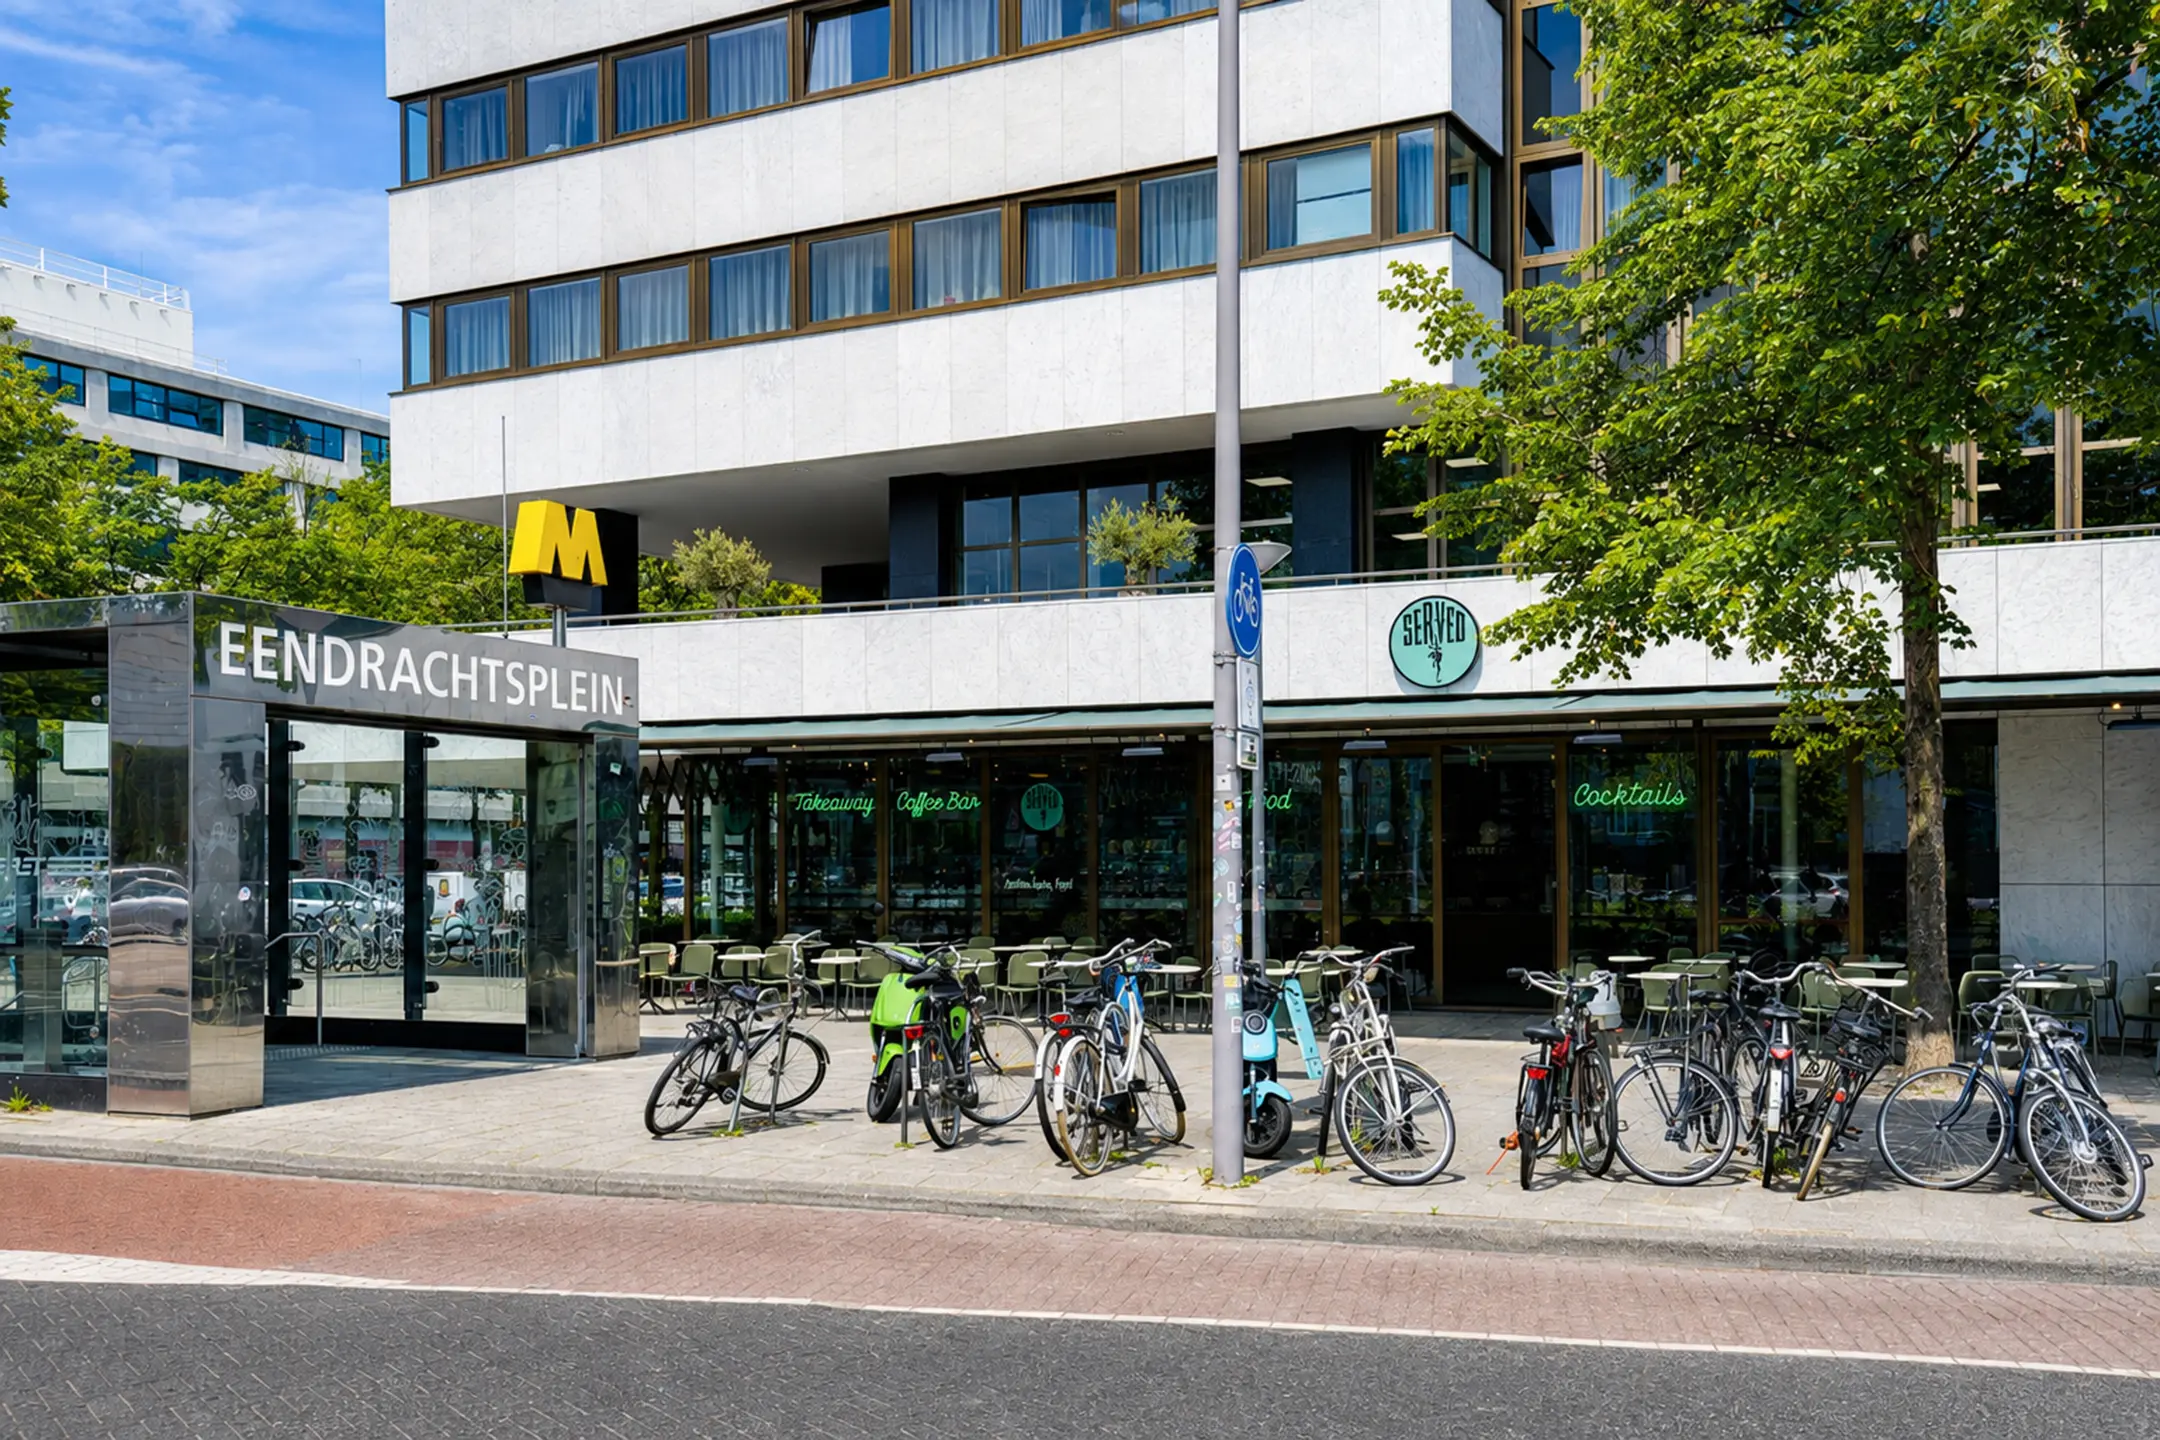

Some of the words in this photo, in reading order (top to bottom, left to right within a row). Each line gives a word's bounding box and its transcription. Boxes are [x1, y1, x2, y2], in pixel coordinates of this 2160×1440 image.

[509, 500, 608, 586] M
[1403, 601, 1465, 646] SERVED
[219, 620, 624, 716] EENDRACHTSPLEIN
[795, 793, 876, 817] Takeaway
[897, 791, 944, 817] Coffee
[946, 791, 981, 810] Bar
[1242, 788, 1292, 810] Fod
[1574, 782, 1687, 806] Cocktails
